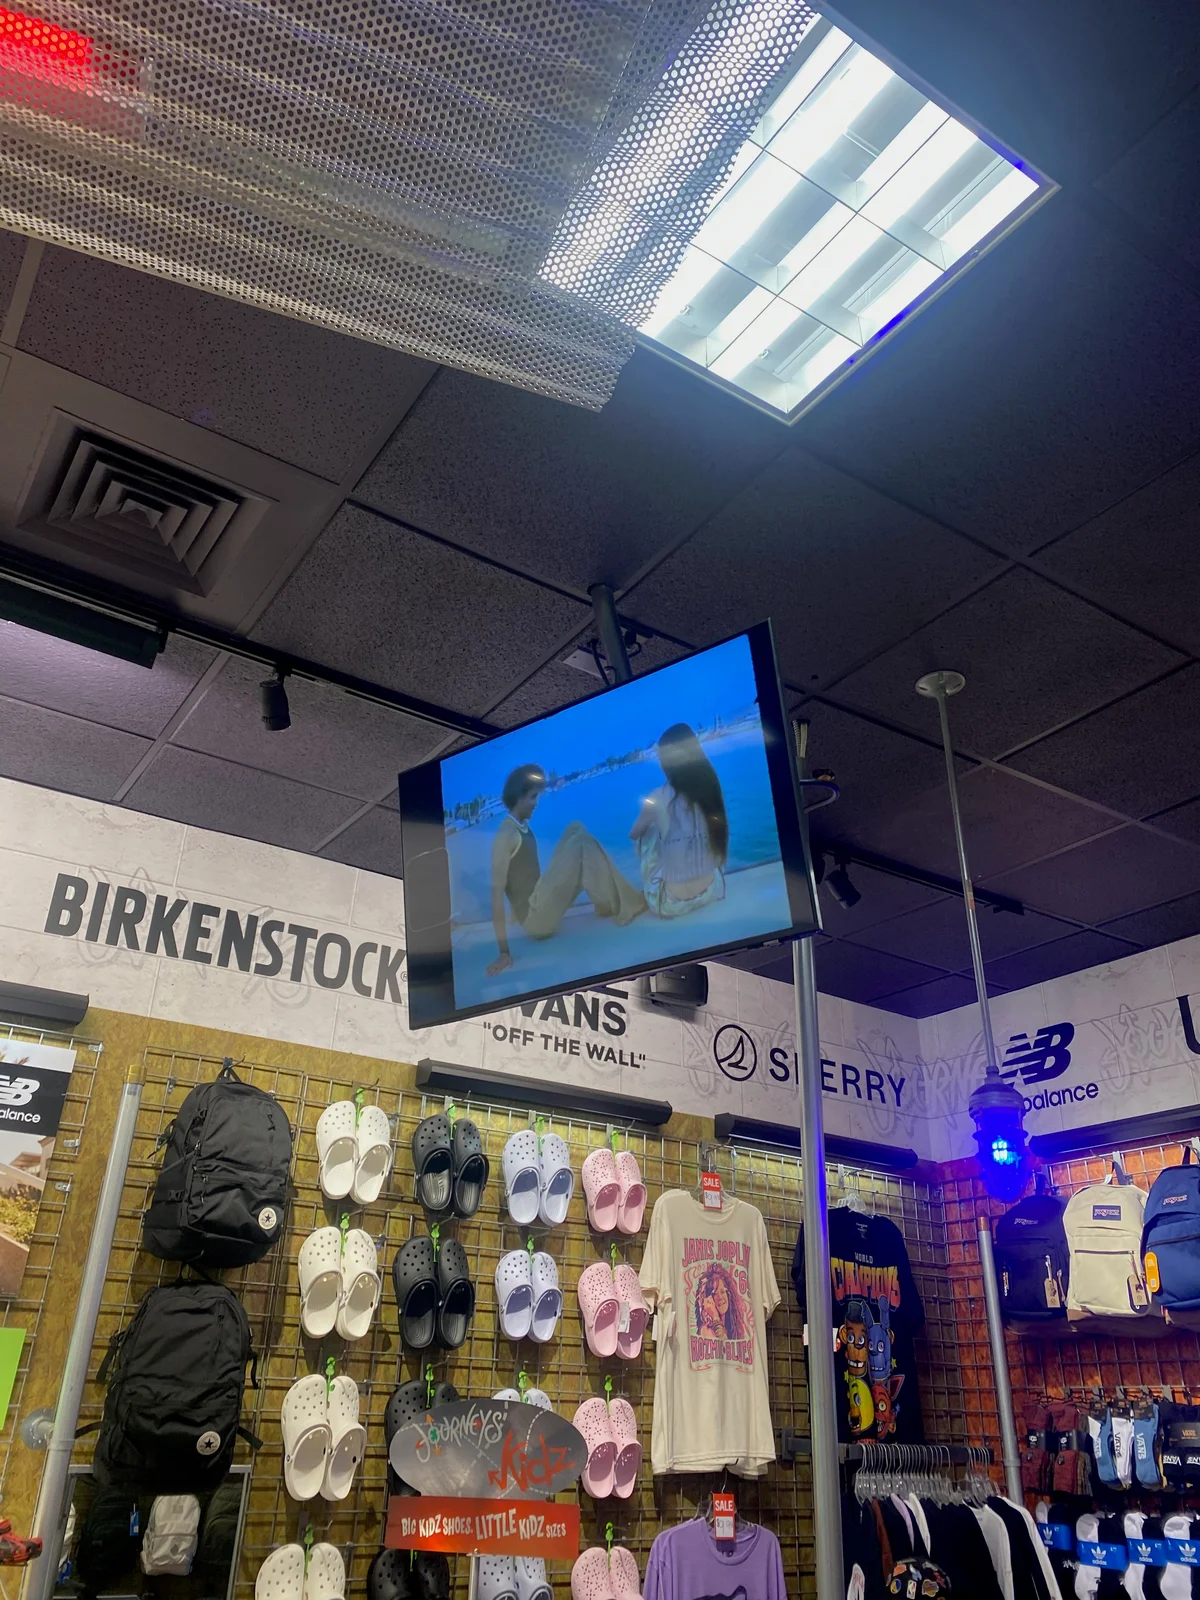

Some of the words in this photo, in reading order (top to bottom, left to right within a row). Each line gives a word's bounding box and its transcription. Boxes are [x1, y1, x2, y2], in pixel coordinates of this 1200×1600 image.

[44, 873, 407, 1004] BIRKENSTOCK
[483, 1021, 535, 1047] "OFF
[540, 1033, 581, 1057] THE
[585, 1042, 646, 1069] WALL"
[769, 1047, 906, 1108] SERRY
[0, 1107, 41, 1124] alance
[703, 1176, 720, 1189] SALE
[682, 1237, 715, 1268] JANIS
[854, 1251, 874, 1265] WORLD
[1135, 1432, 1147, 1460] VANS
[714, 1500, 734, 1512] SALE
[401, 1516, 417, 1537] BIG
[418, 1513, 442, 1538] KIDZ
[442, 1516, 474, 1536] SHOES.
[475, 1507, 517, 1541] LITTLE
[519, 1515, 545, 1540] KIDZ
[546, 1522, 567, 1538] SIZES
